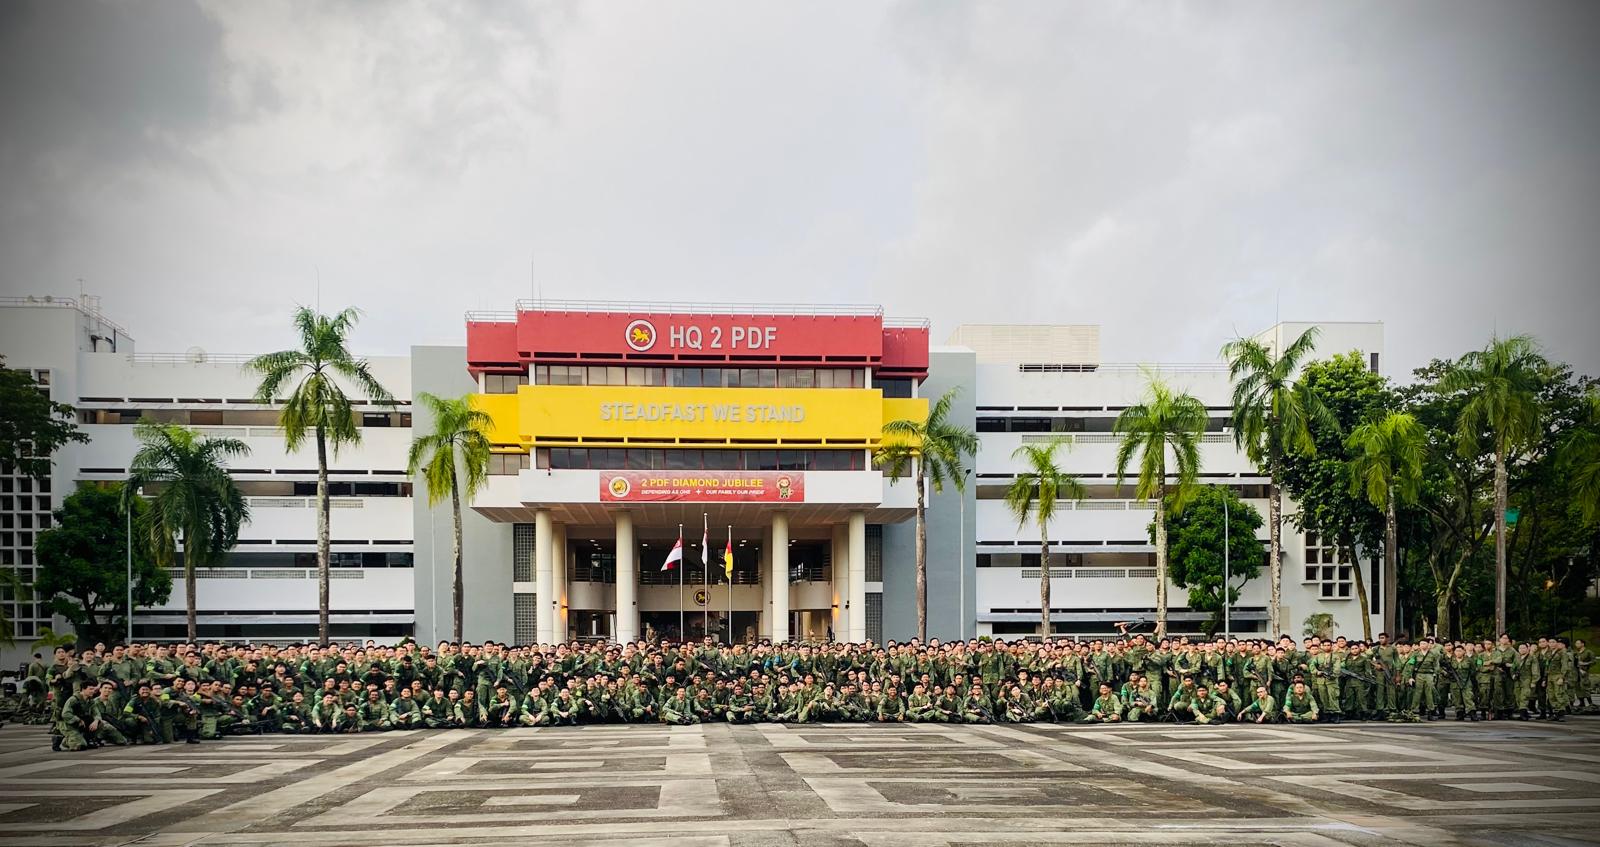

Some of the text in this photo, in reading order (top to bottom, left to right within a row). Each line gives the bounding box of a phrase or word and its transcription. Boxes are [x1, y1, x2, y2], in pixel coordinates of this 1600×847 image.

[669, 325, 777, 350] HQ 2 PDF
[600, 403, 805, 423] STEADFAST WE STAND
[641, 478, 764, 487] 2 PDF DIAMOND JUBILEE
